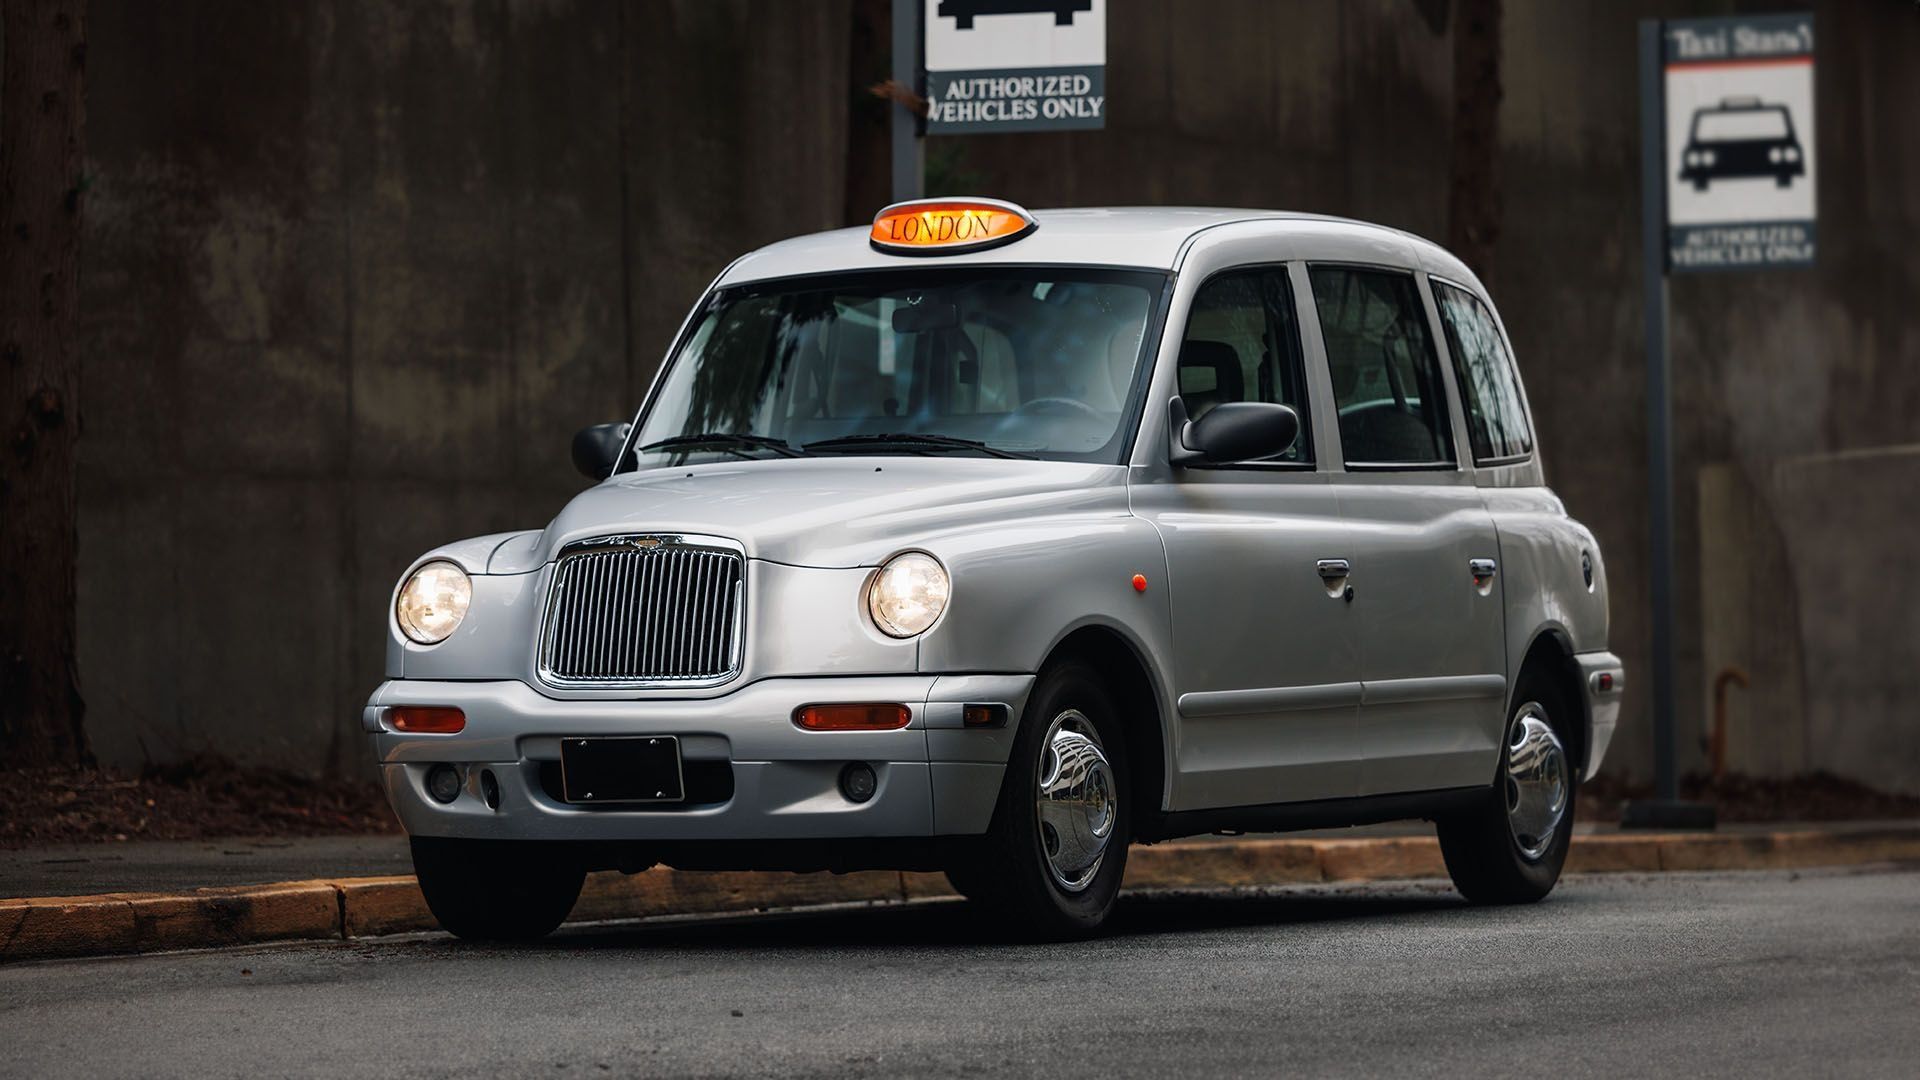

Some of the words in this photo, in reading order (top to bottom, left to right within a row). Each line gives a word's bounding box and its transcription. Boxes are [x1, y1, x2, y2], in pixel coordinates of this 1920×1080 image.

[1671, 28, 1727, 57] Taxi
[946, 74, 1091, 100] AUTHORIZED
[1042, 96, 1105, 119] ONLY
[890, 215, 993, 242] LONDON
